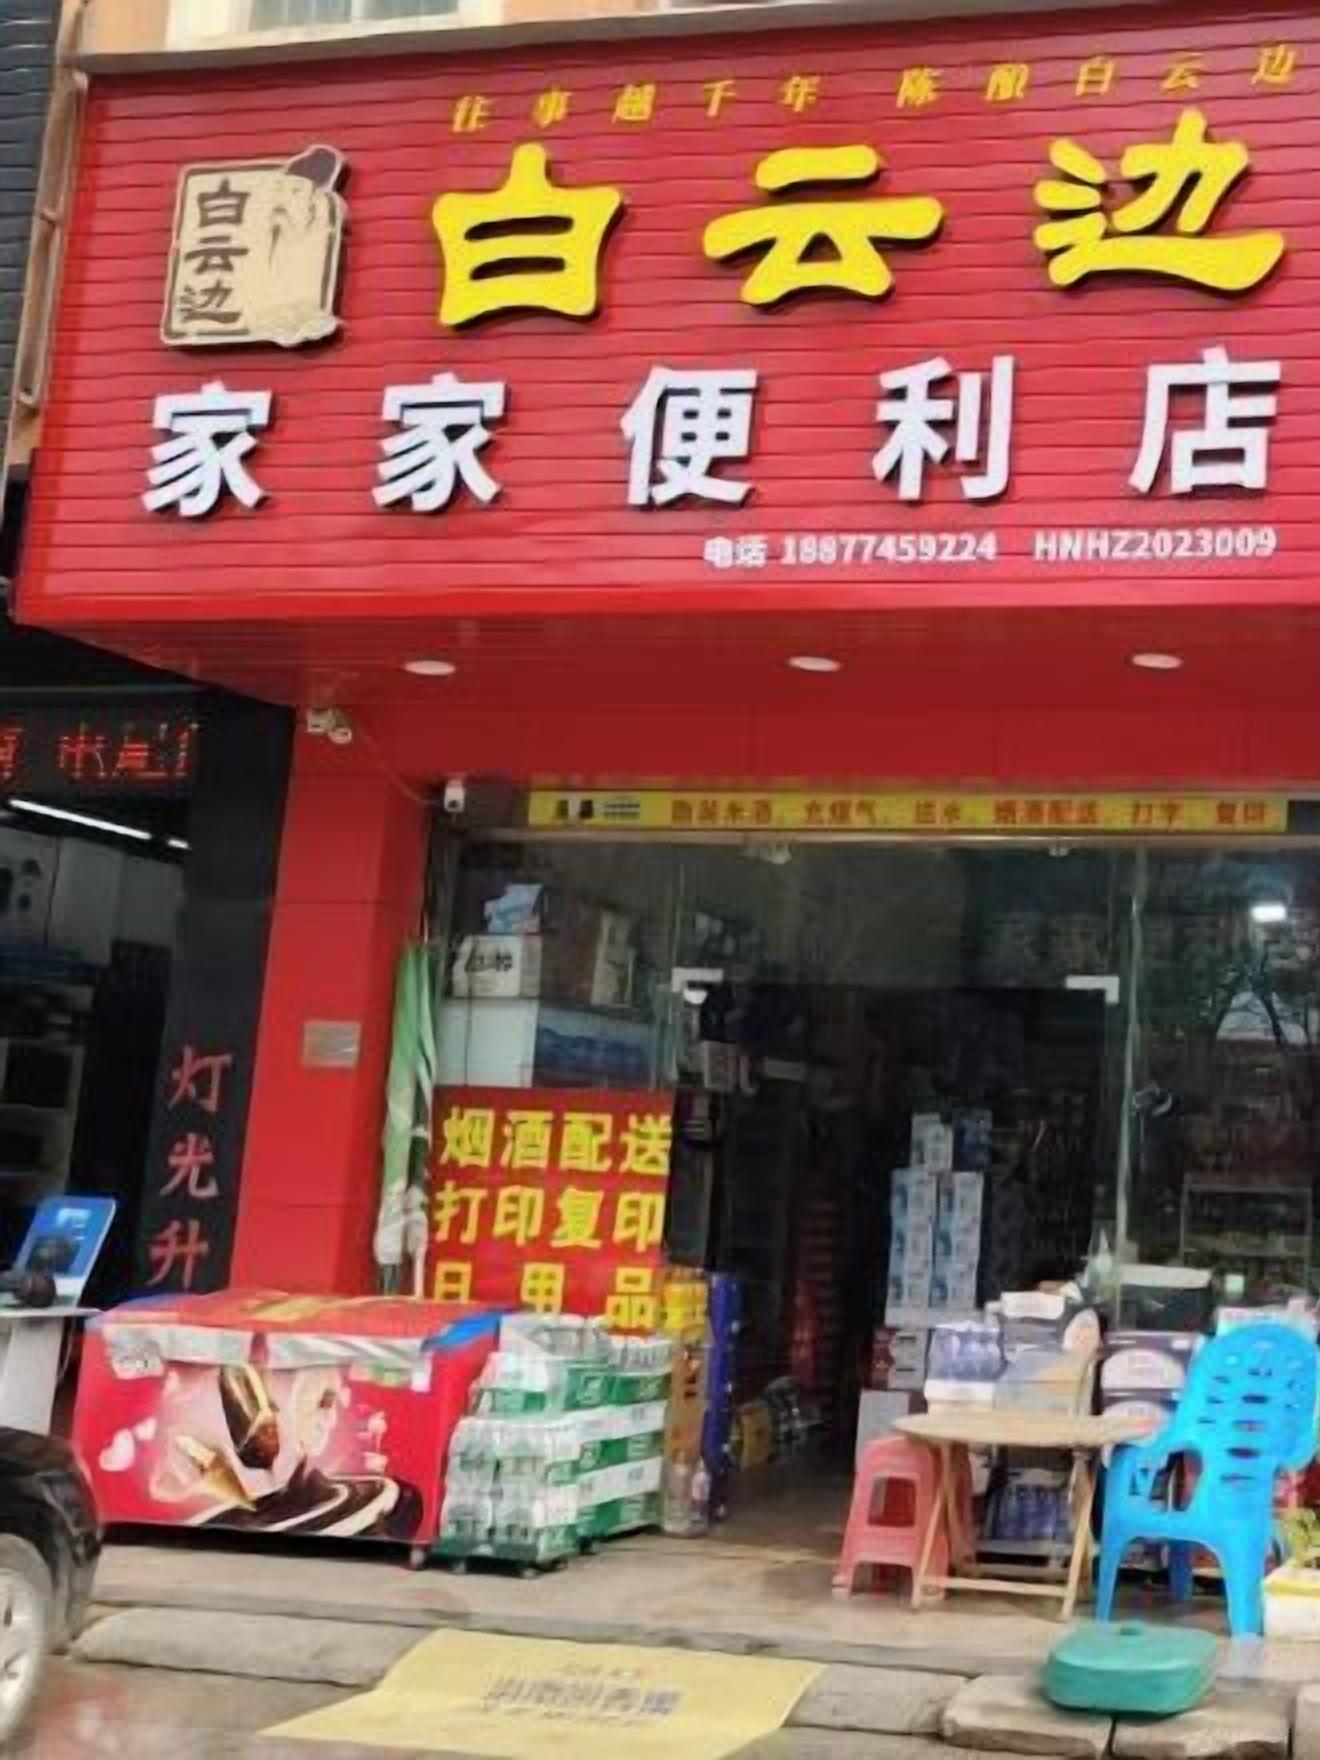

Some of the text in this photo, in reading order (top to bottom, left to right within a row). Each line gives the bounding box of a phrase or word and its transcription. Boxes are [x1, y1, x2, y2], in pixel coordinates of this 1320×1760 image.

[179, 176, 251, 324] 白云边
[432, 108, 1286, 330] 白云边
[142, 346, 1284, 519] 家家便利店
[780, 531, 998, 566] 18877459224
[1033, 526, 1278, 562] HNHZ2023009
[147, 1044, 232, 1290] 灯光升
[440, 1106, 674, 1176] 烟酒配送
[433, 1180, 667, 1253] 打印复印
[433, 1261, 656, 1330] 日用品
